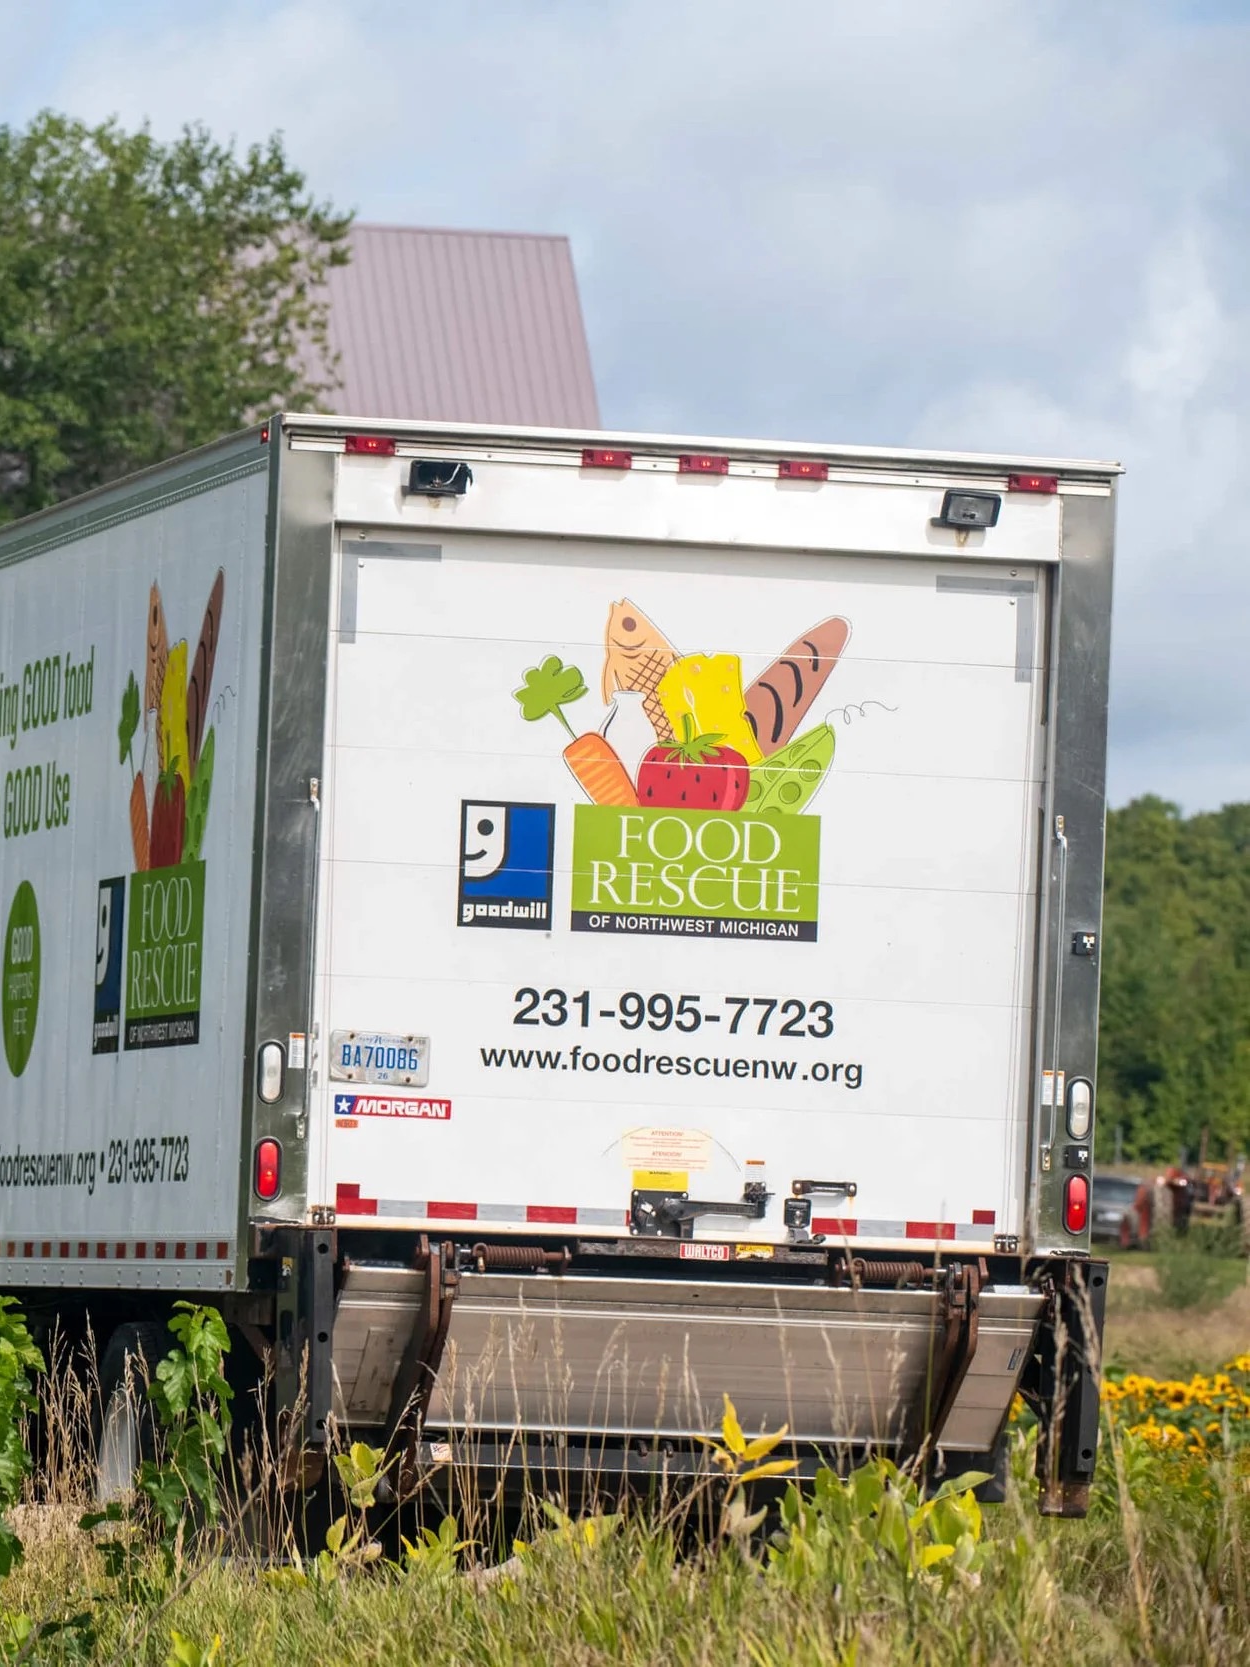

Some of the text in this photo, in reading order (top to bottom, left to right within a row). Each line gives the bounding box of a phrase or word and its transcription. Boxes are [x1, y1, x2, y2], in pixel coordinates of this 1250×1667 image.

[22, 655, 61, 732] GOOD
[63, 645, 95, 719] food
[4, 765, 42, 839] GOOD
[45, 761, 70, 829] Use
[617, 814, 782, 864] FOOD
[141, 876, 193, 943] FOOD
[462, 900, 548, 923] goodwill
[588, 860, 801, 914] RESCUE
[588, 915, 799, 937] OF NORTHWEST MICHIGAN
[130, 943, 198, 1010] RESCUE
[513, 987, 835, 1039] 231-995-7723
[355, 1098, 447, 1118] MORGAN
[108, 1135, 190, 1184] 231-995-7723
[684, 1244, 725, 1259] WALTCO
